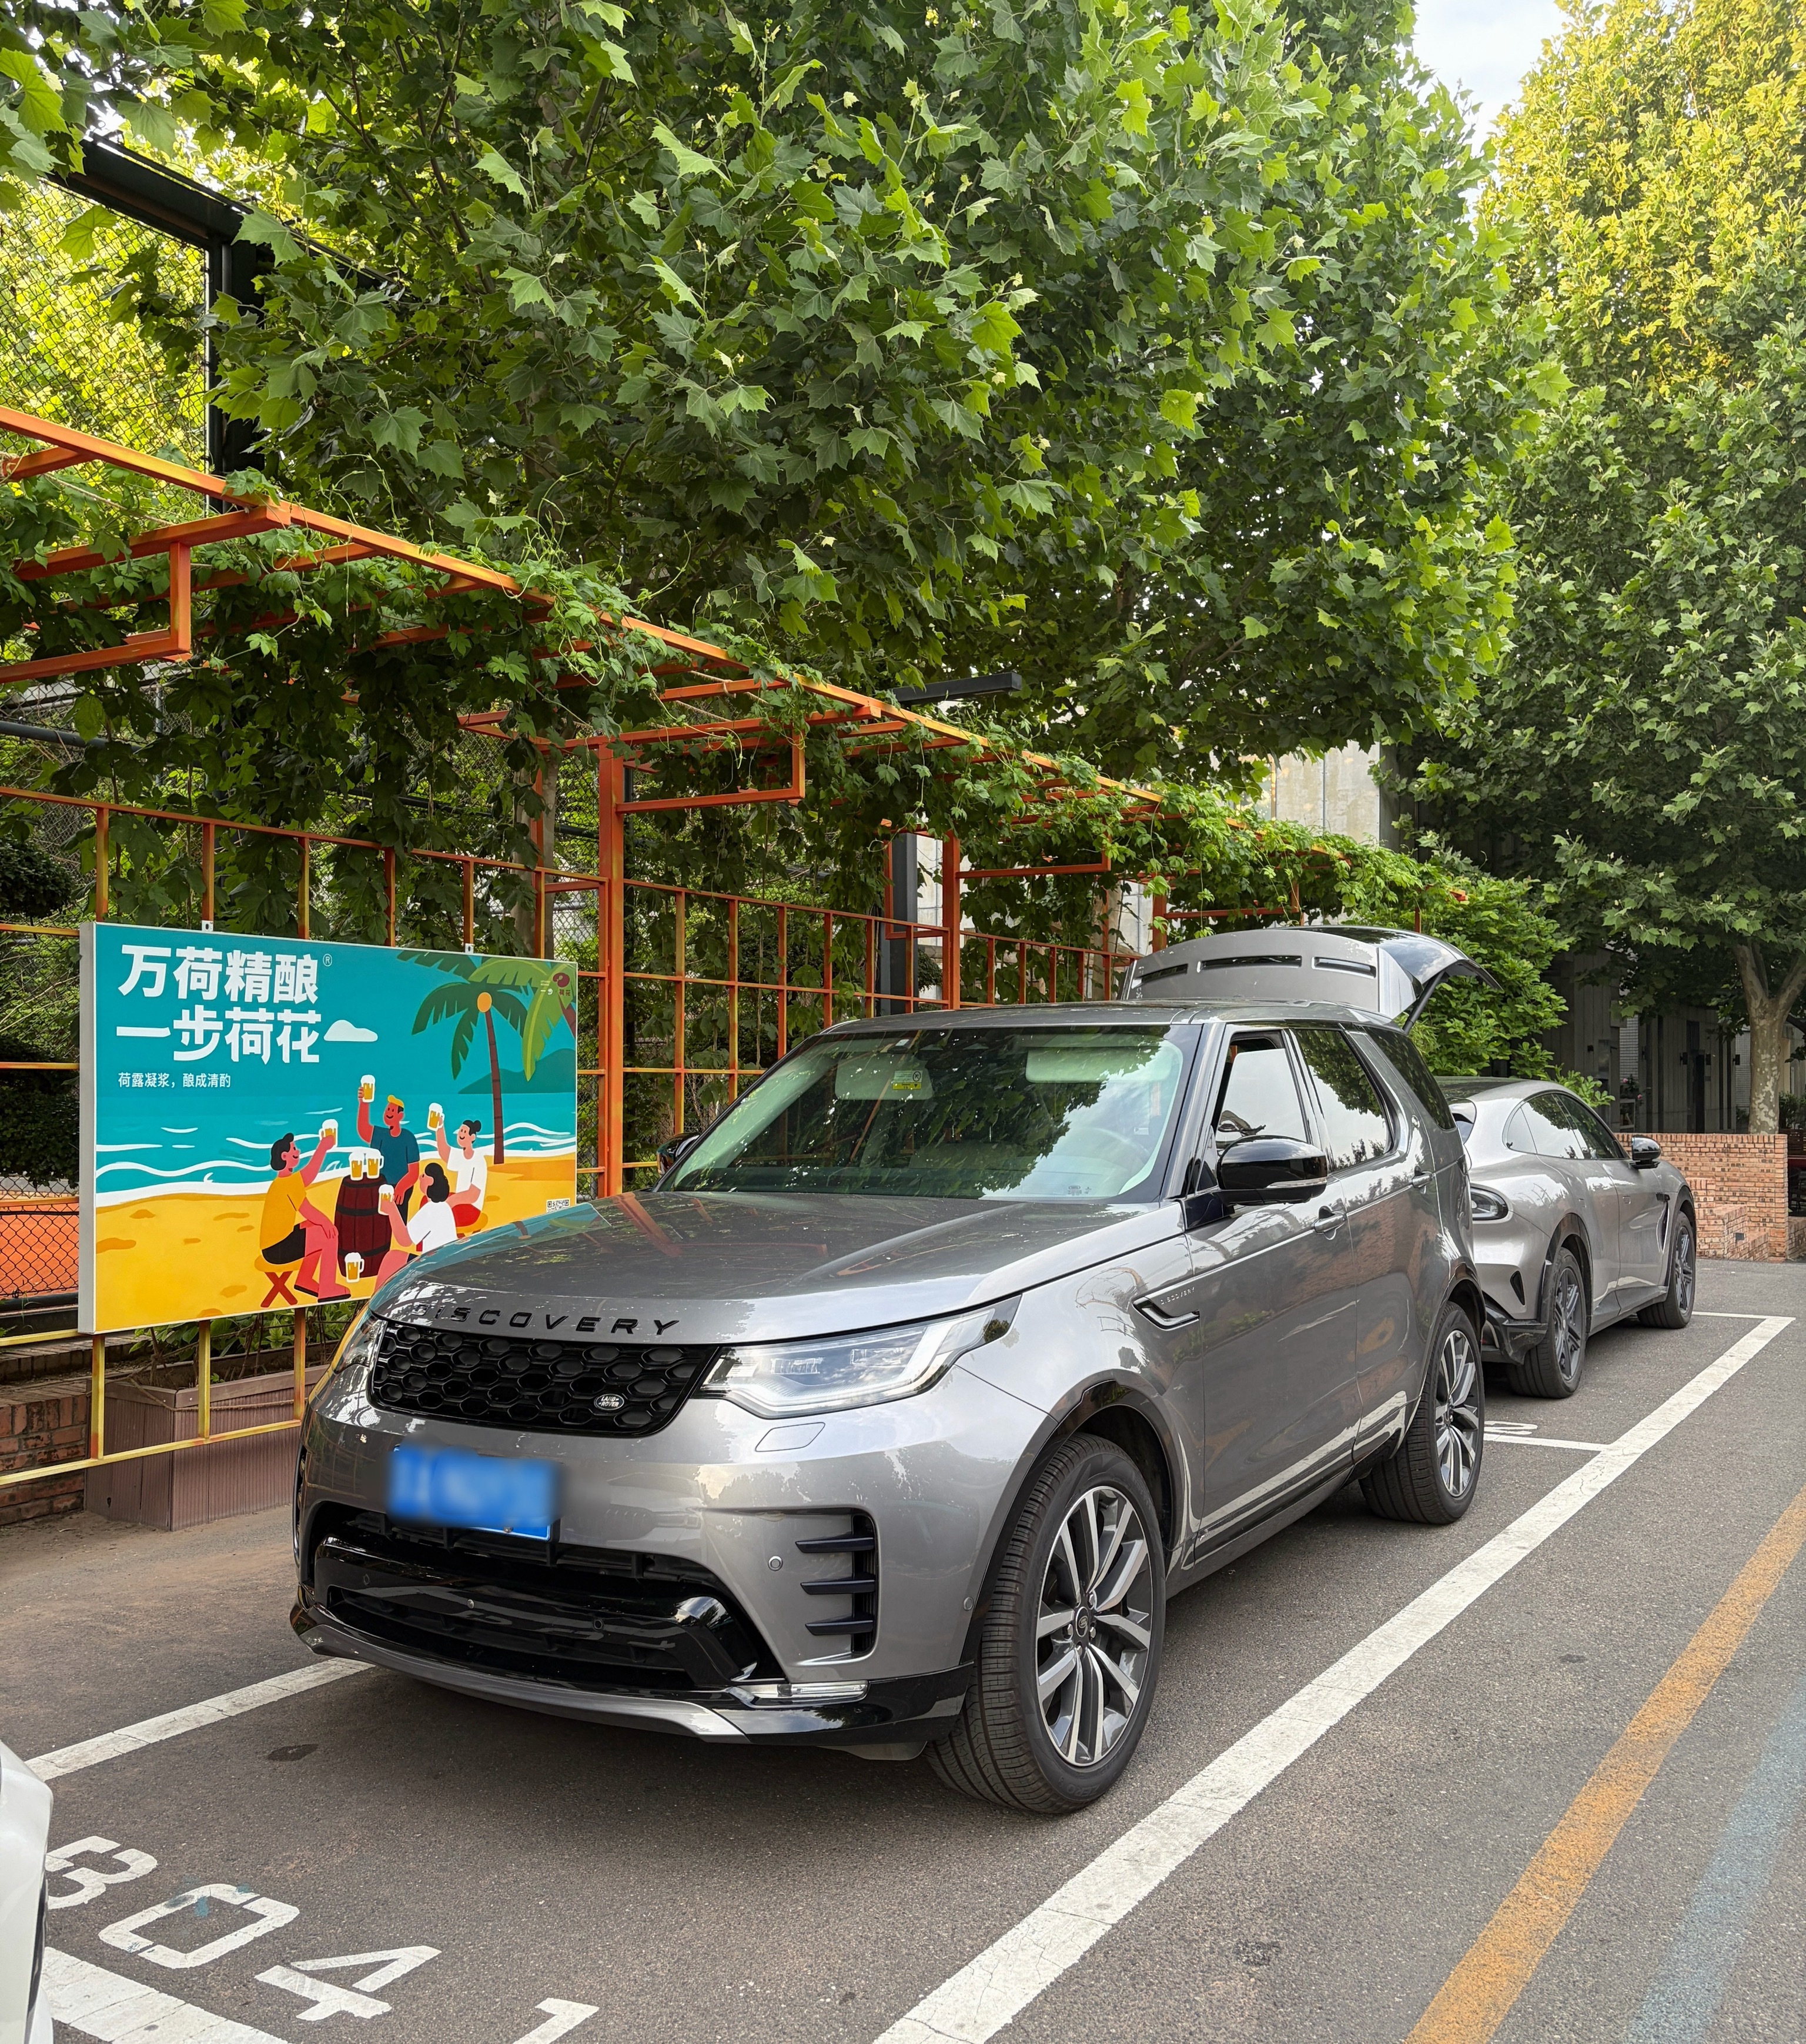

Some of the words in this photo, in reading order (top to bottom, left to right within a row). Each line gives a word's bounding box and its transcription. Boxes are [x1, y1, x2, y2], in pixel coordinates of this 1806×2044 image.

[116, 1004, 322, 1065] 一步荷花
[411, 1301, 680, 1335] DISCOVERY
